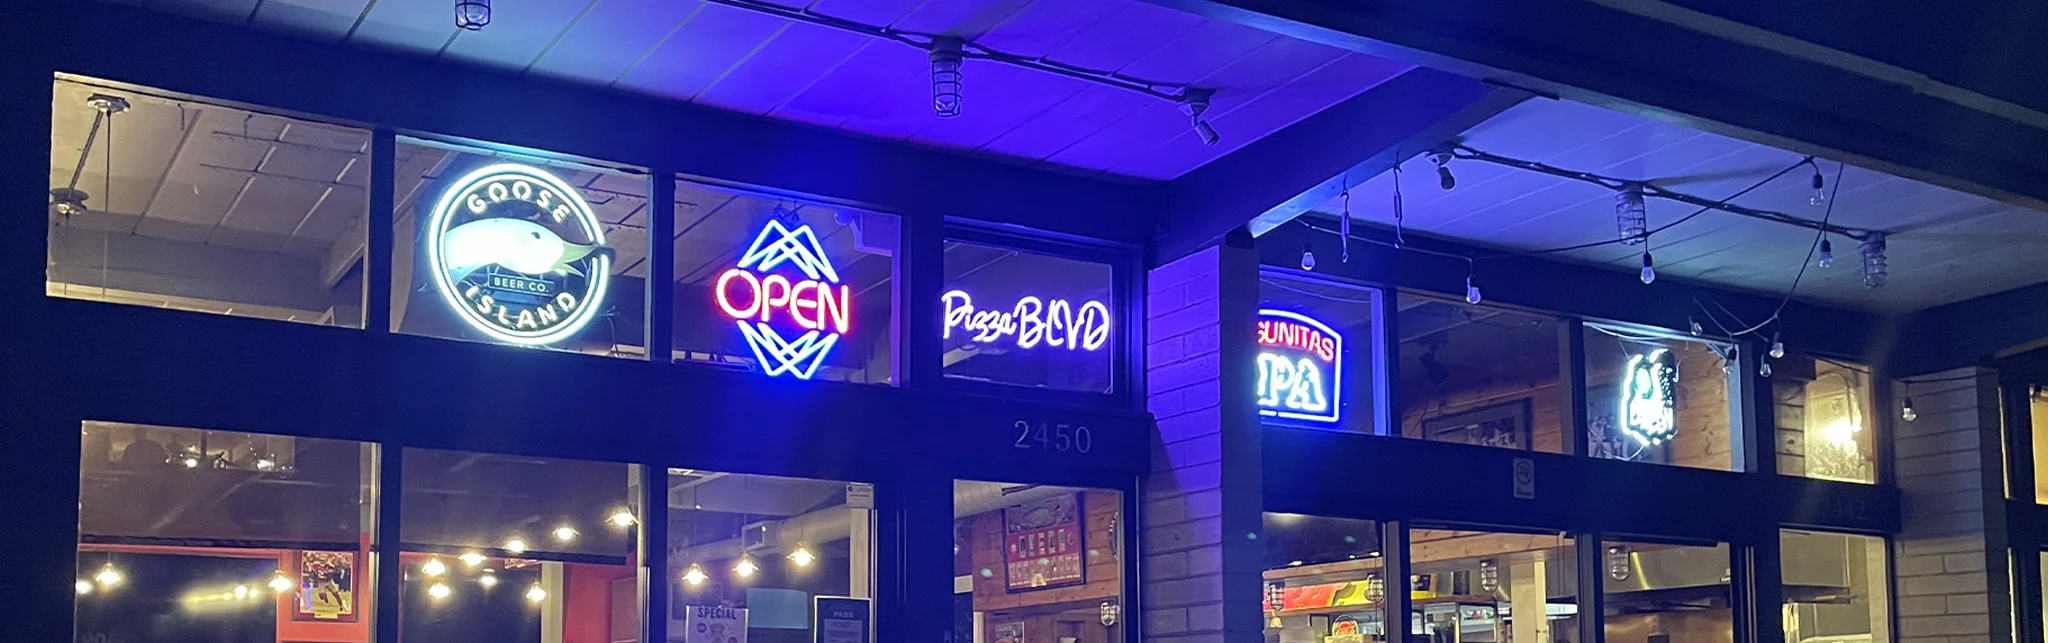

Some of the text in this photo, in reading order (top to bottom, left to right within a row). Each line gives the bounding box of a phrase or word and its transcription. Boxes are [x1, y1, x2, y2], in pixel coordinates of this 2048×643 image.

[467, 180, 570, 224] GOOSE
[493, 277, 549, 293] BEER CO.
[716, 268, 849, 334] OPEN
[466, 285, 576, 329] ISLAND
[1014, 420, 1092, 454] 2450
[697, 607, 737, 620] SPECIAL
